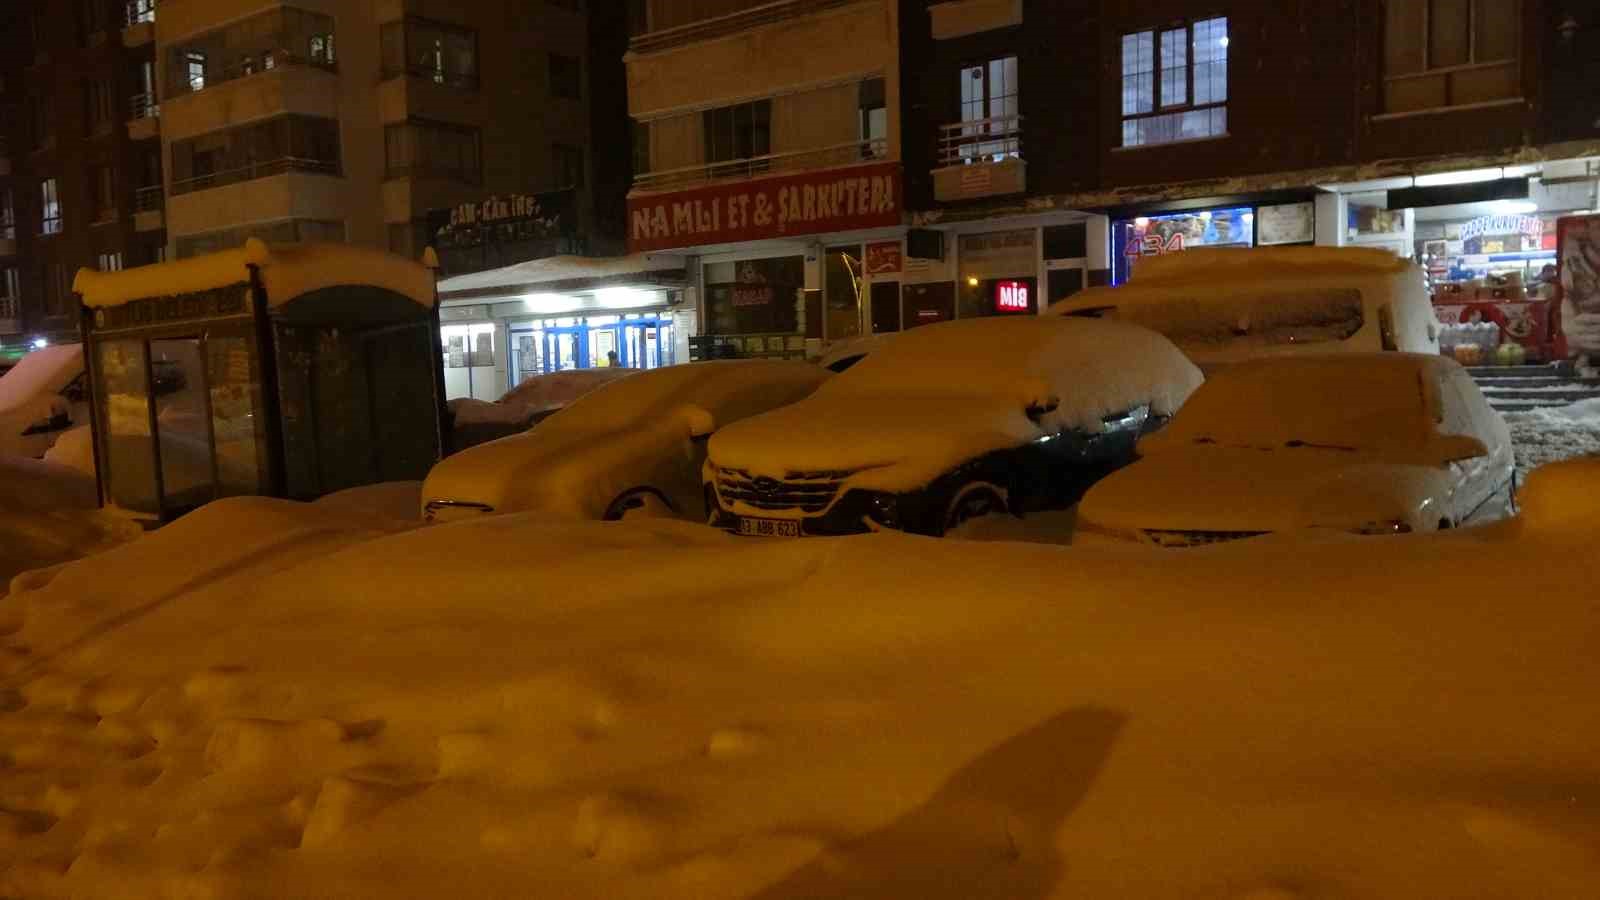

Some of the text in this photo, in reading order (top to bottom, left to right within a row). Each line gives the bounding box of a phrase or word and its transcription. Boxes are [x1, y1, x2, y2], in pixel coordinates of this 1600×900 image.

[631, 197, 721, 240] NAMLI
[727, 194, 752, 230] ET
[752, 192, 775, 226] &
